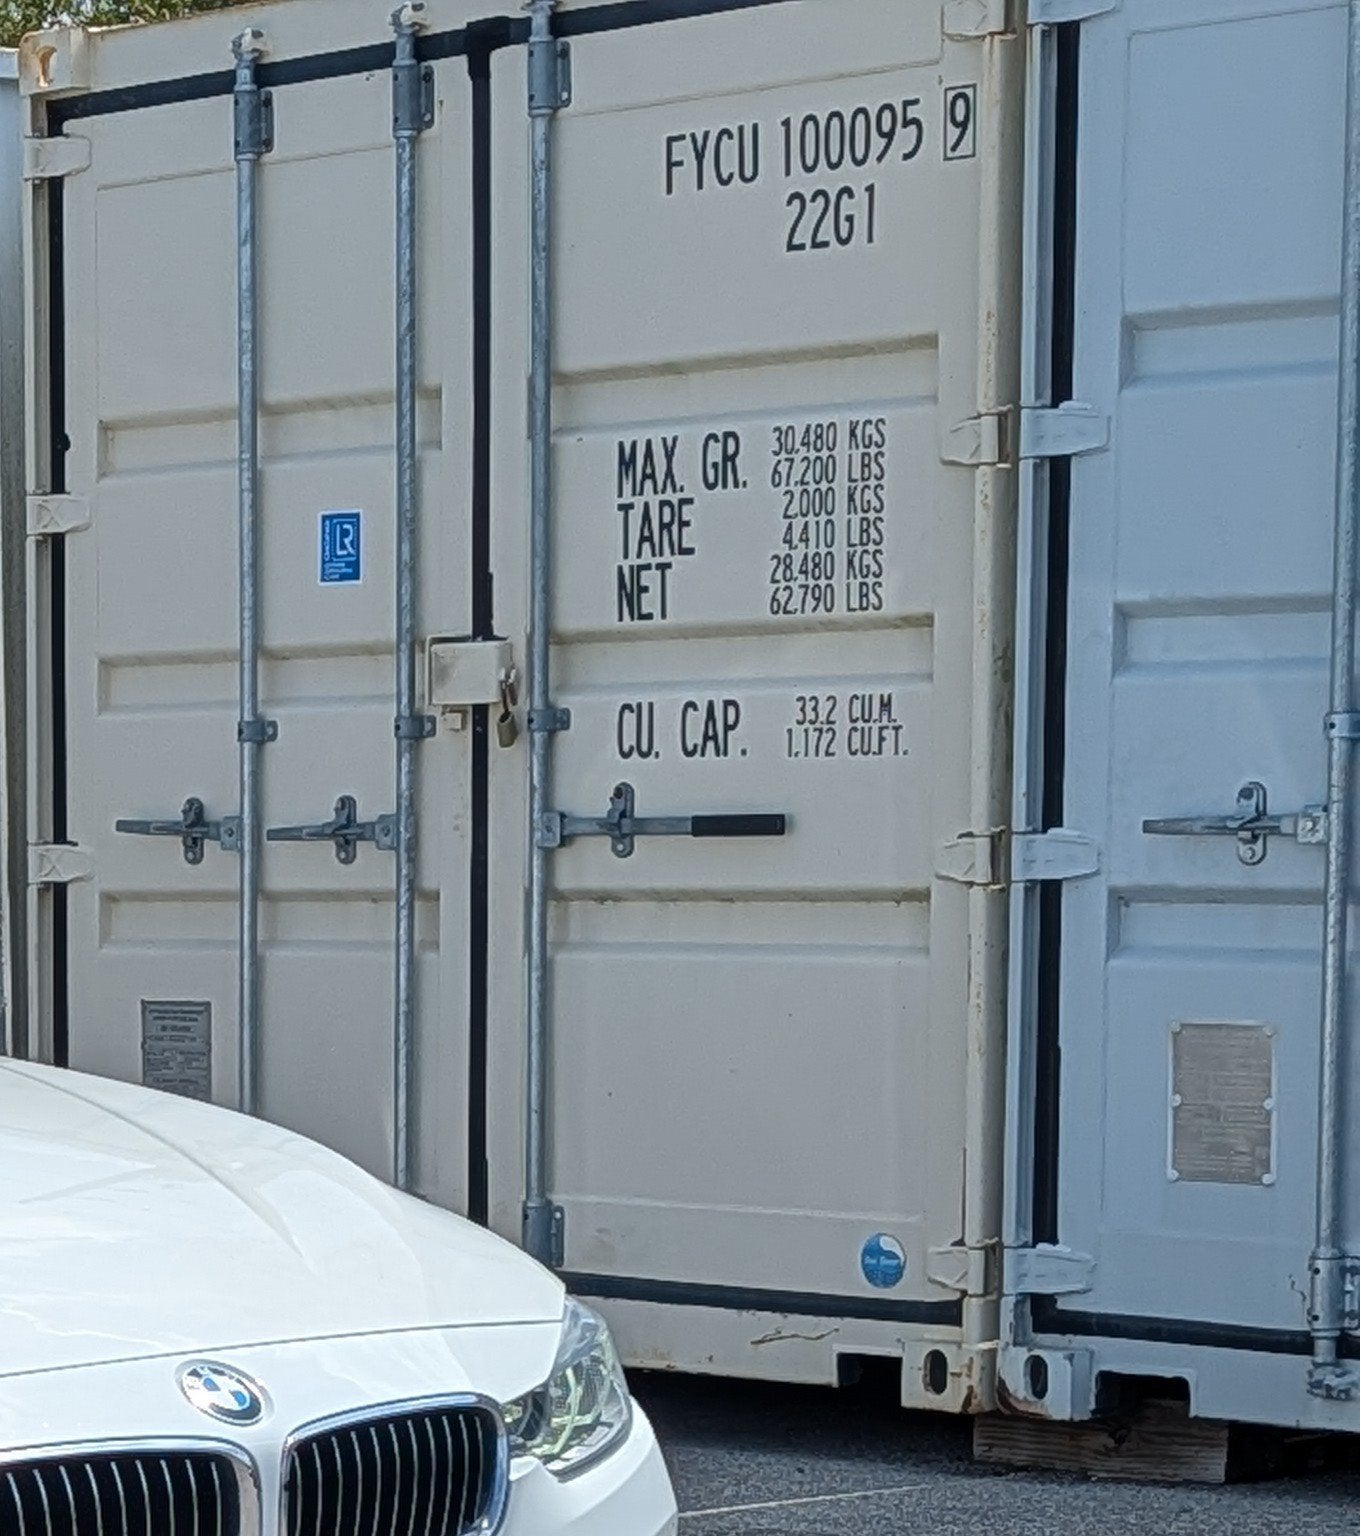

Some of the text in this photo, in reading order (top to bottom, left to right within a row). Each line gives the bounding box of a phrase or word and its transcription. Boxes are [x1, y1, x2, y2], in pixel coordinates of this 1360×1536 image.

[666, 90, 972, 195] FYCU 100095 9
[786, 183, 874, 252] 22G1
[772, 418, 885, 455] 30.480 KGS
[617, 431, 747, 497] MAX. GR.
[771, 452, 885, 488] 67.200 LBS
[783, 484, 884, 519] 2.000 KGS
[617, 498, 696, 559] TARE
[783, 517, 884, 549] 4.410 LBS
[770, 549, 883, 584] 28.480 KGS
[617, 562, 672, 622] NET
[770, 581, 882, 615] 62.790 LBS
[796, 693, 897, 725] 33.2 CU.M.
[617, 700, 747, 759] CU. CAP.
[786, 725, 908, 757] 1.172 CU.FT.
